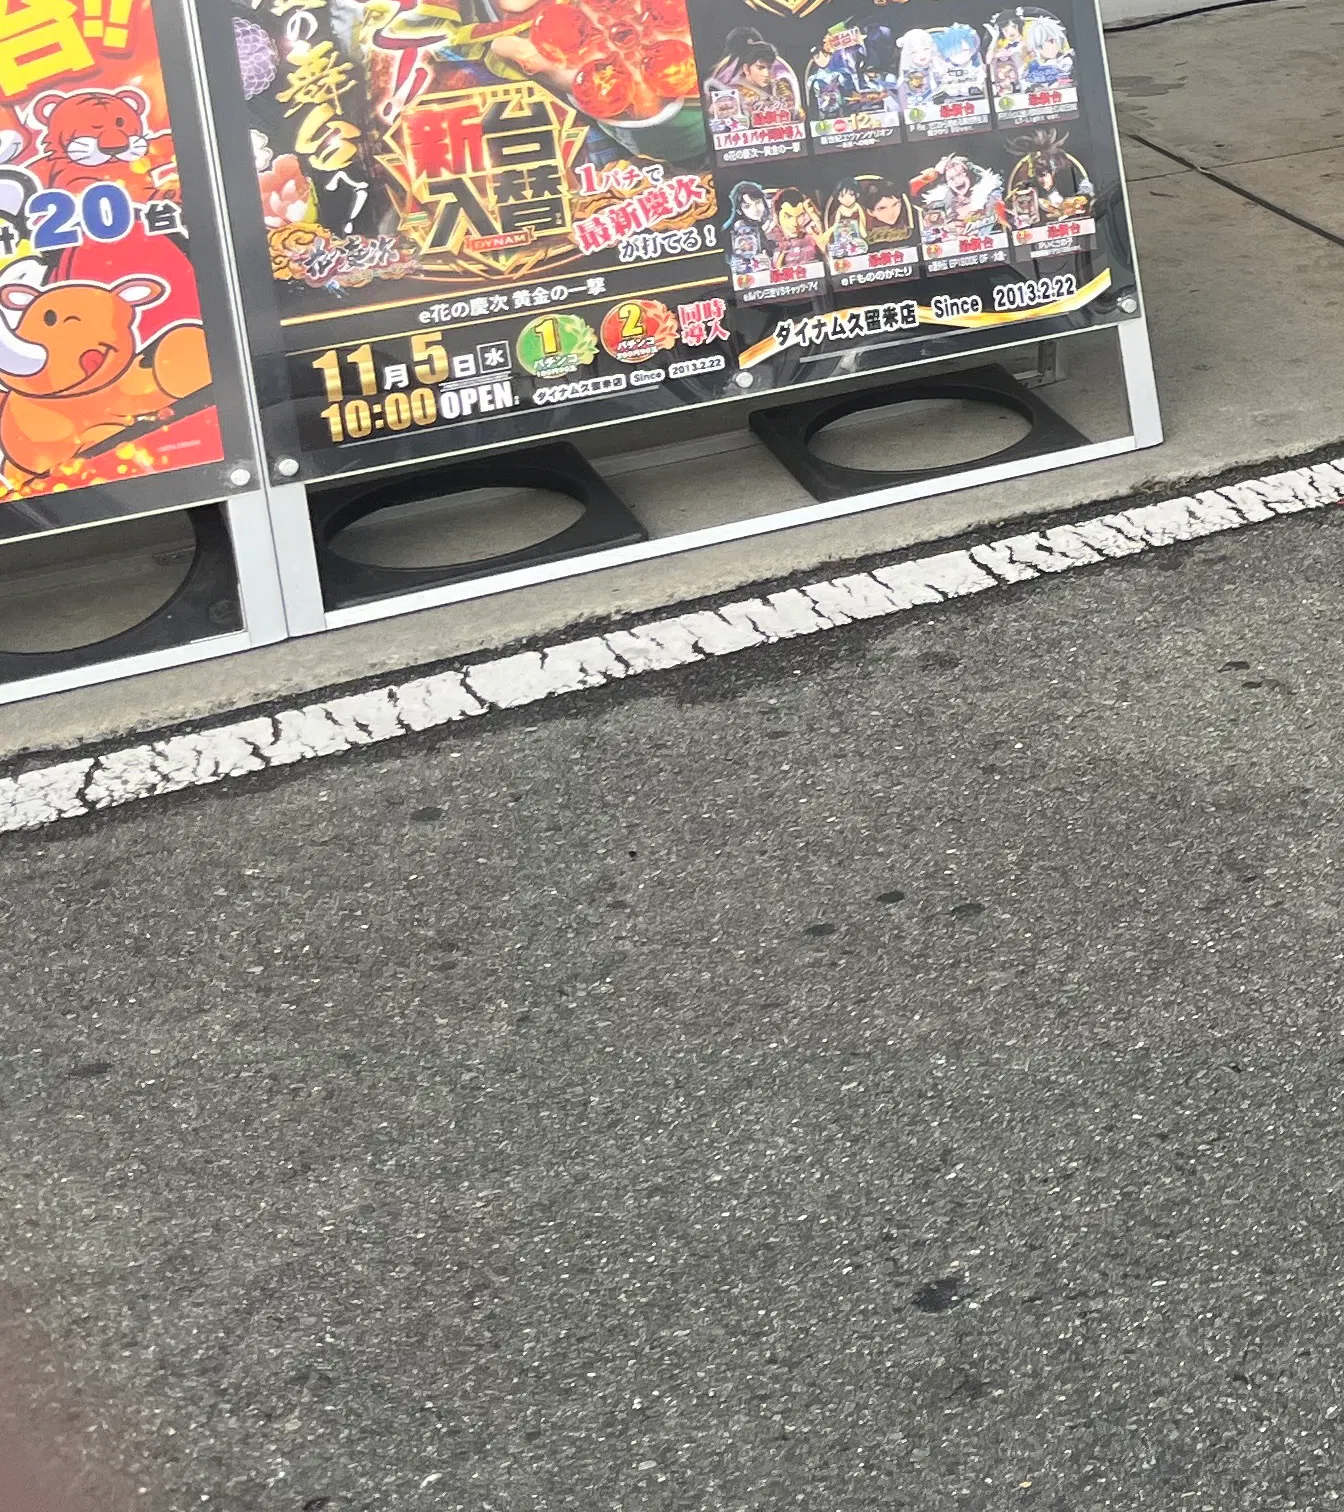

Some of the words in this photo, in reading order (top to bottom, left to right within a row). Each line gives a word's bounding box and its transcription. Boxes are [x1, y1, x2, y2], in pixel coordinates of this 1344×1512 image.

[473, 233, 529, 251] DYNAM
[618, 302, 645, 339] 2
[774, 301, 919, 346] ダイナム久留米店
[933, 295, 981, 320] Since
[994, 275, 1077, 310] 2013.2.22
[633, 370, 663, 384] Since
[670, 357, 723, 377] 2013.2.22
